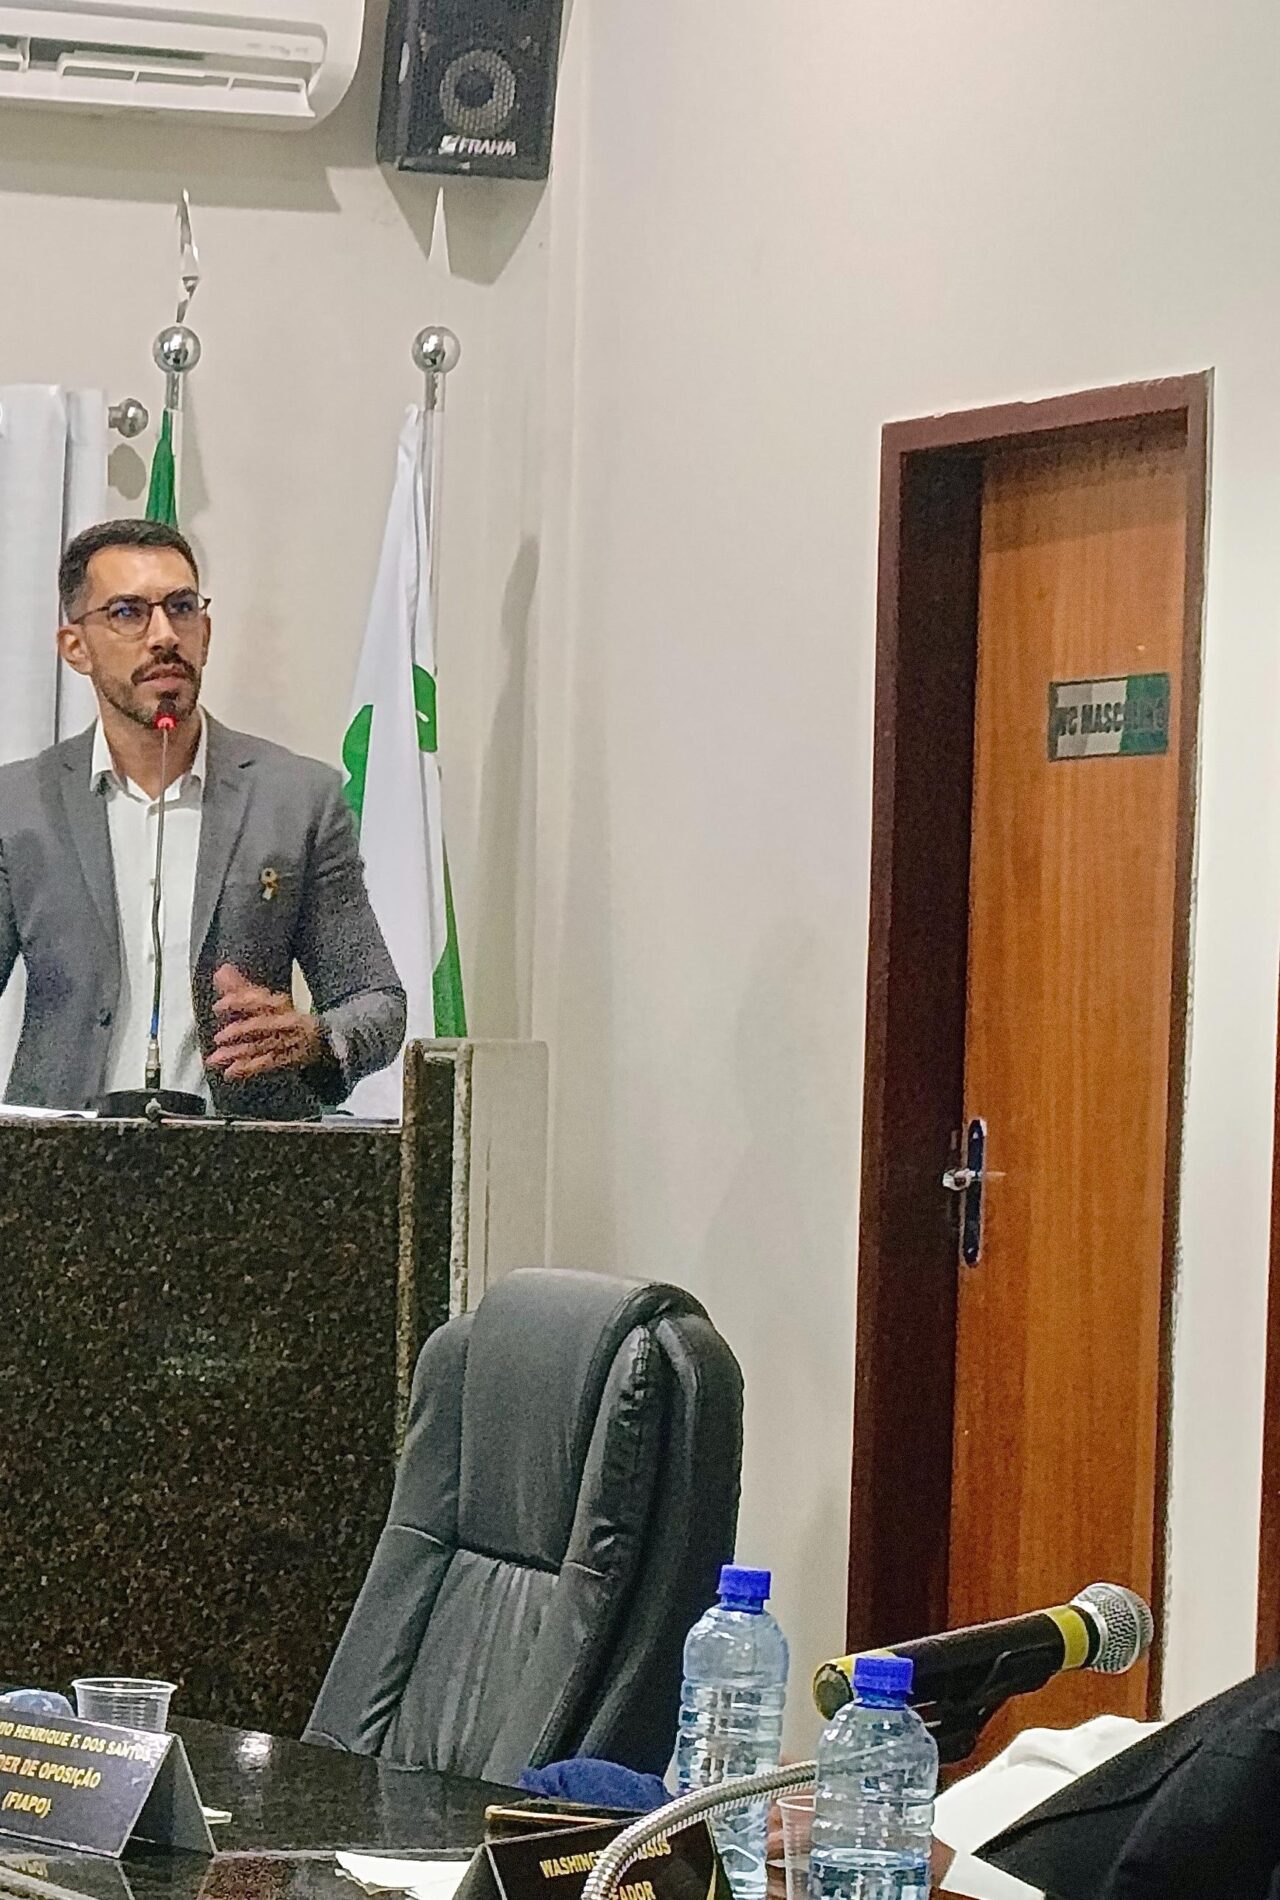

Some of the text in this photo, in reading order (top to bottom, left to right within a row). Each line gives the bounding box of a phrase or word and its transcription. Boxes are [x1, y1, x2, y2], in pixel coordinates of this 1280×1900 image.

[458, 137, 517, 156] FRAHM
[13, 1724, 71, 1746] HENRIQUE
[81, 1736, 106, 1753] DOS
[19, 1758, 40, 1777] DE
[38, 1762, 101, 1789] OPOSIÇÃO
[1, 1791, 51, 1819] (FIAPO)
